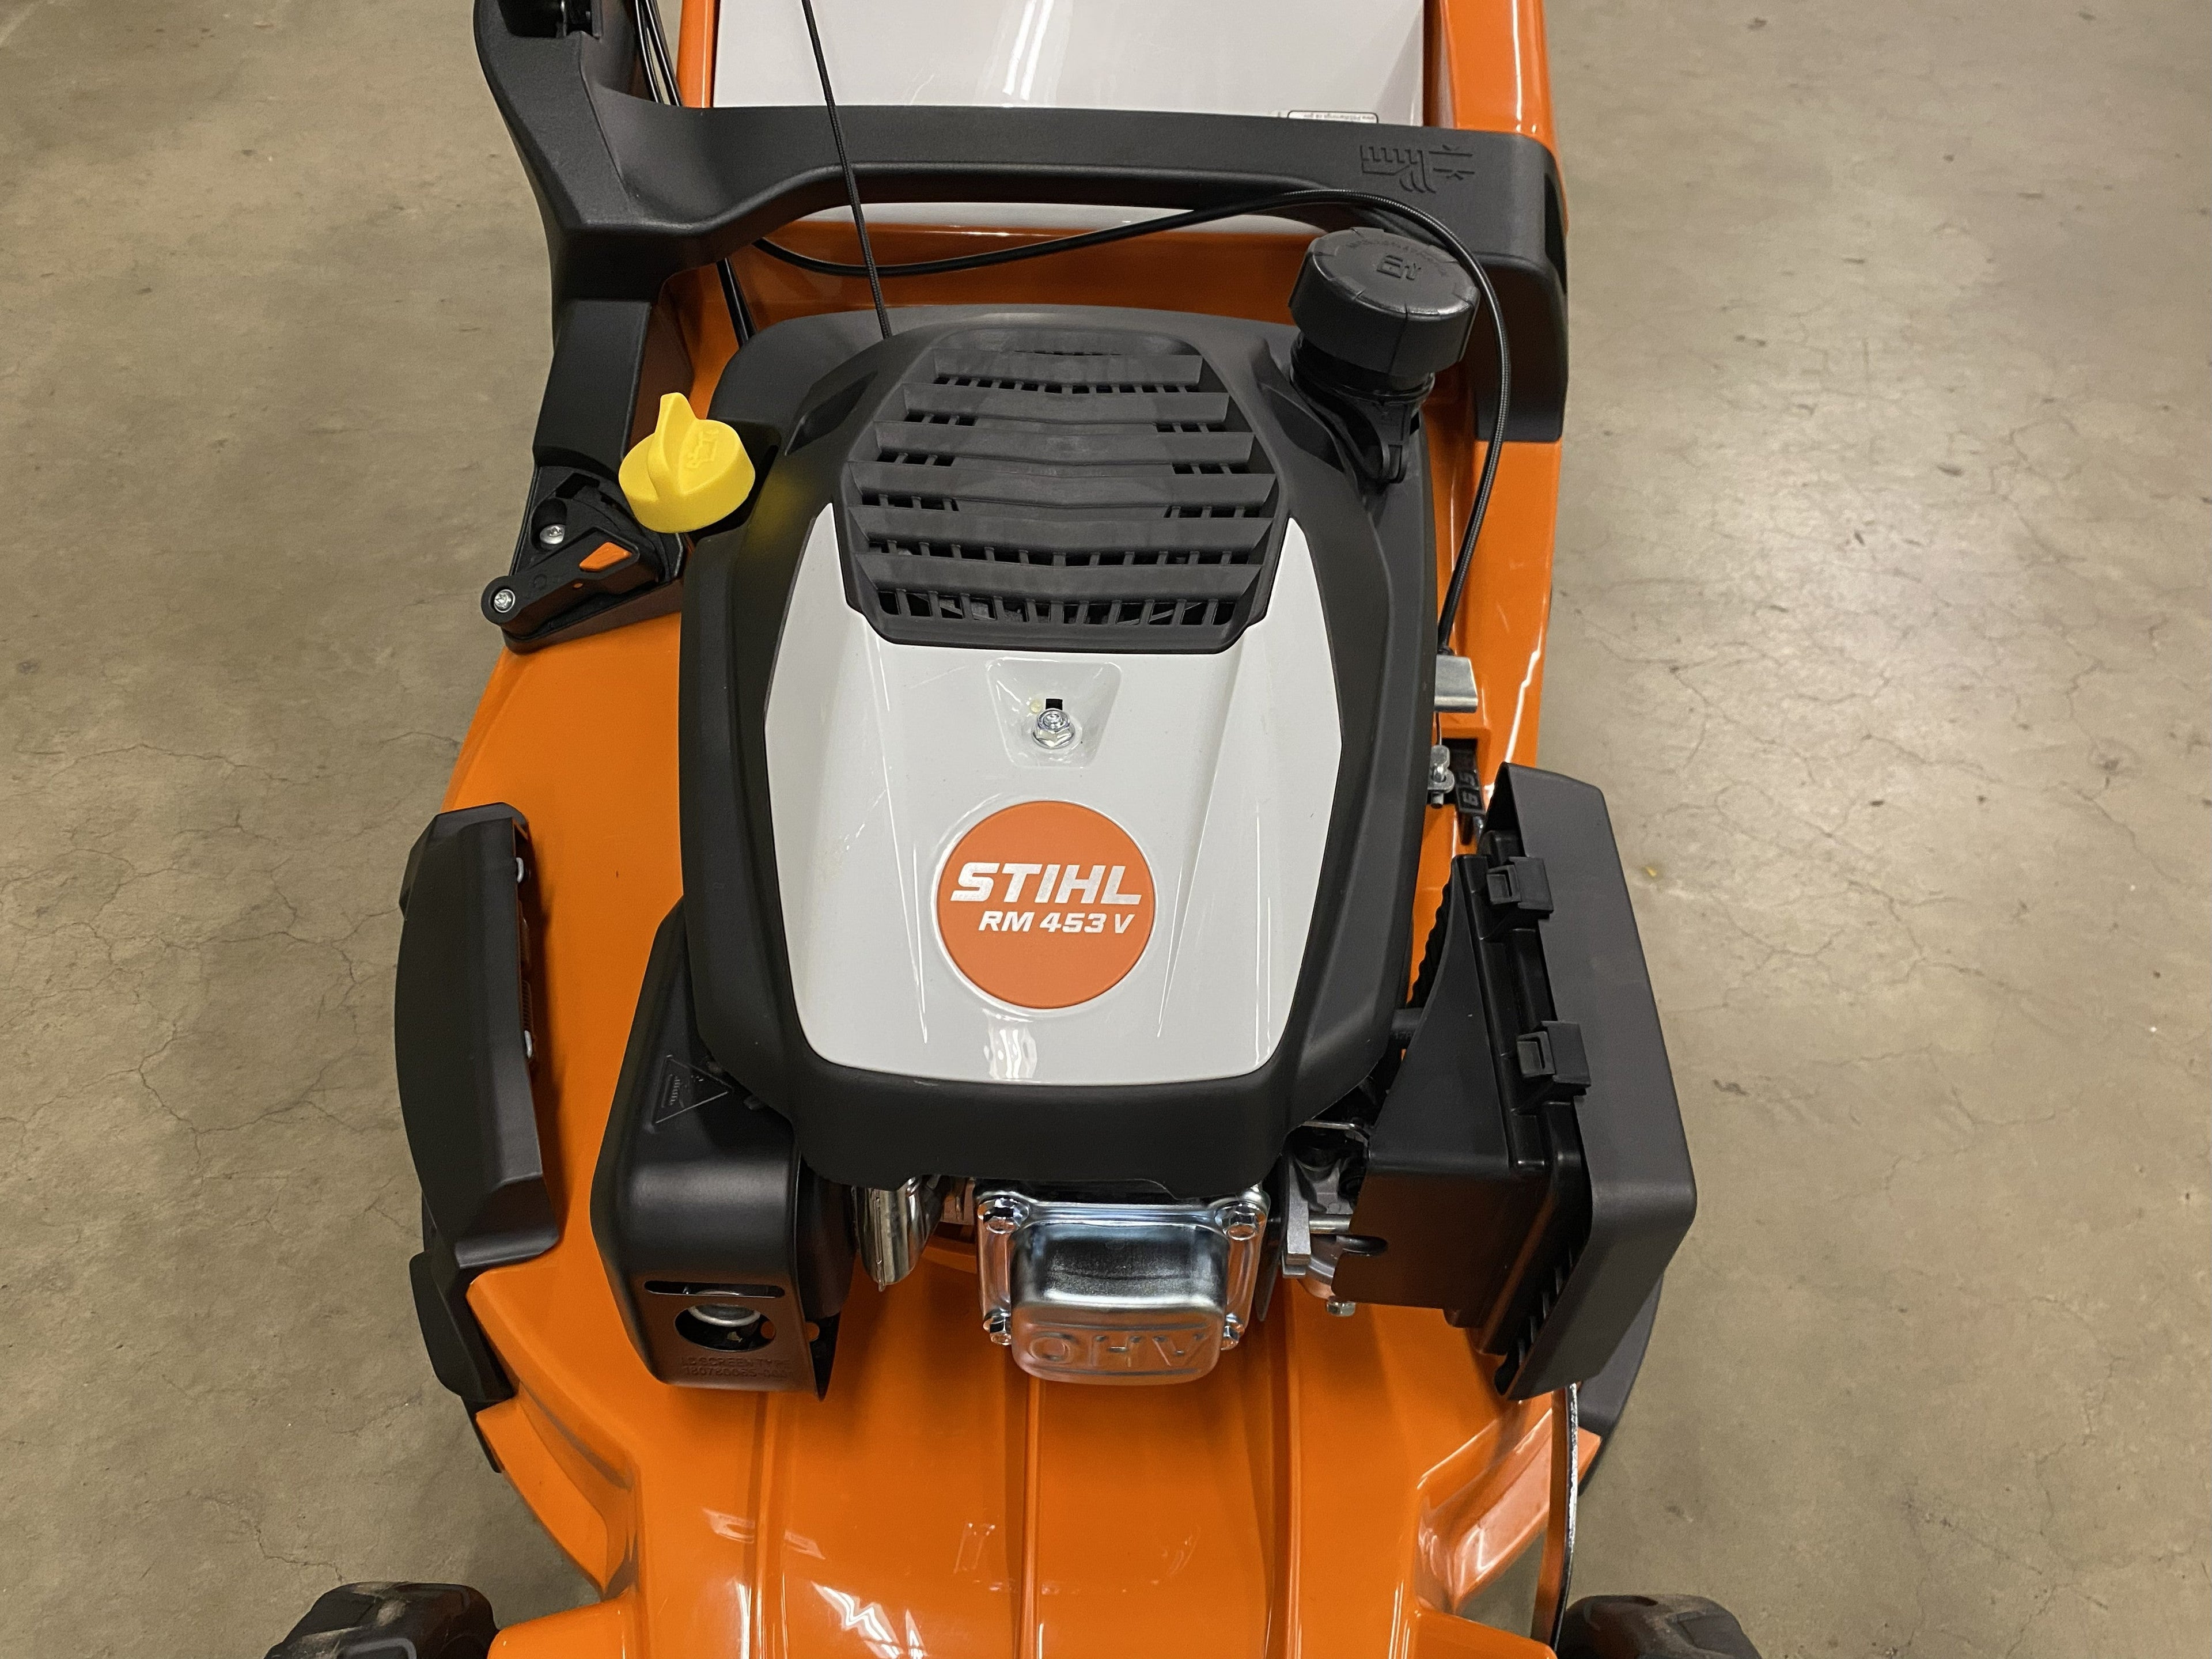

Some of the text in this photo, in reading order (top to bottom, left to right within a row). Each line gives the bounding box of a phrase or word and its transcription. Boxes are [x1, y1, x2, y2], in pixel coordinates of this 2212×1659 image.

[950, 862, 1142, 905] STIHL
[979, 911, 1135, 934] RM 453 V
[1030, 1332, 1206, 1368] OHV
